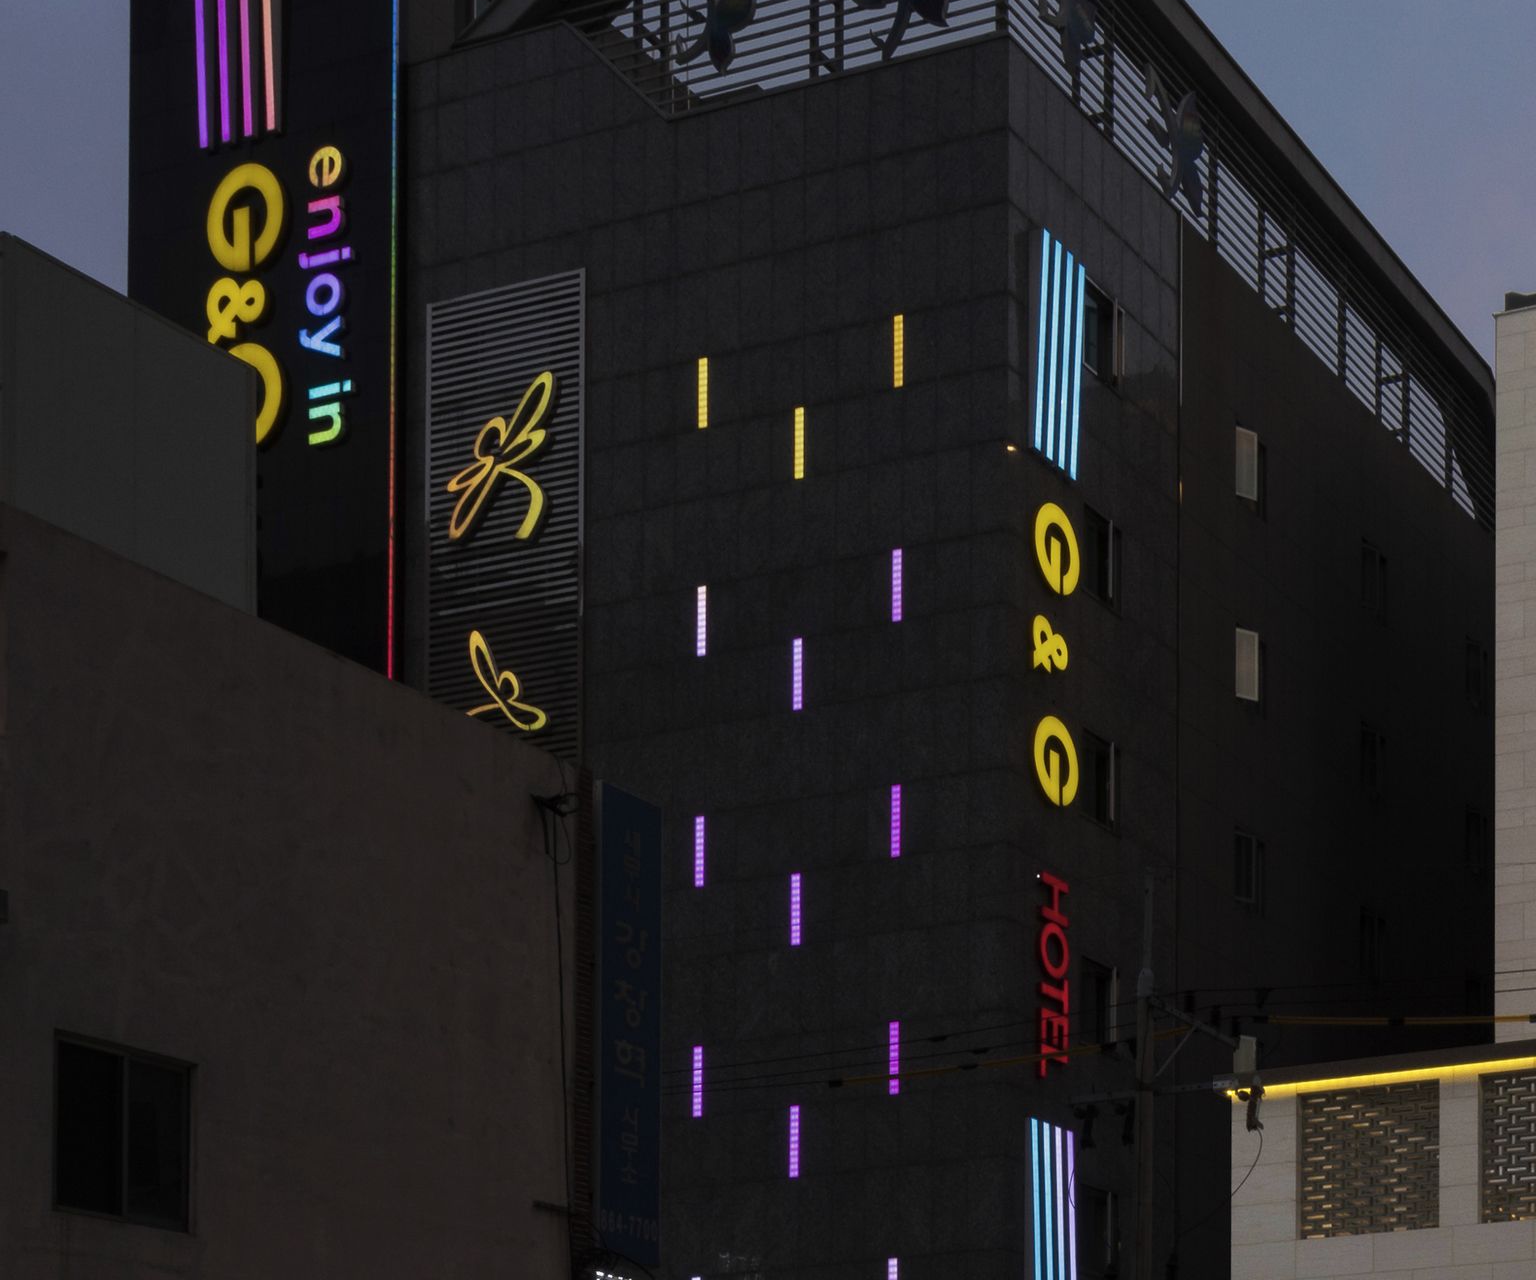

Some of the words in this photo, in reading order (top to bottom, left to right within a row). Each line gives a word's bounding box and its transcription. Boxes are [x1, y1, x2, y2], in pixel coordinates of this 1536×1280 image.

[299, 144, 353, 358] enjoy
[307, 378, 353, 446] in
[1033, 502, 1081, 807] G&G
[1040, 871, 1070, 1079] HOTEL
